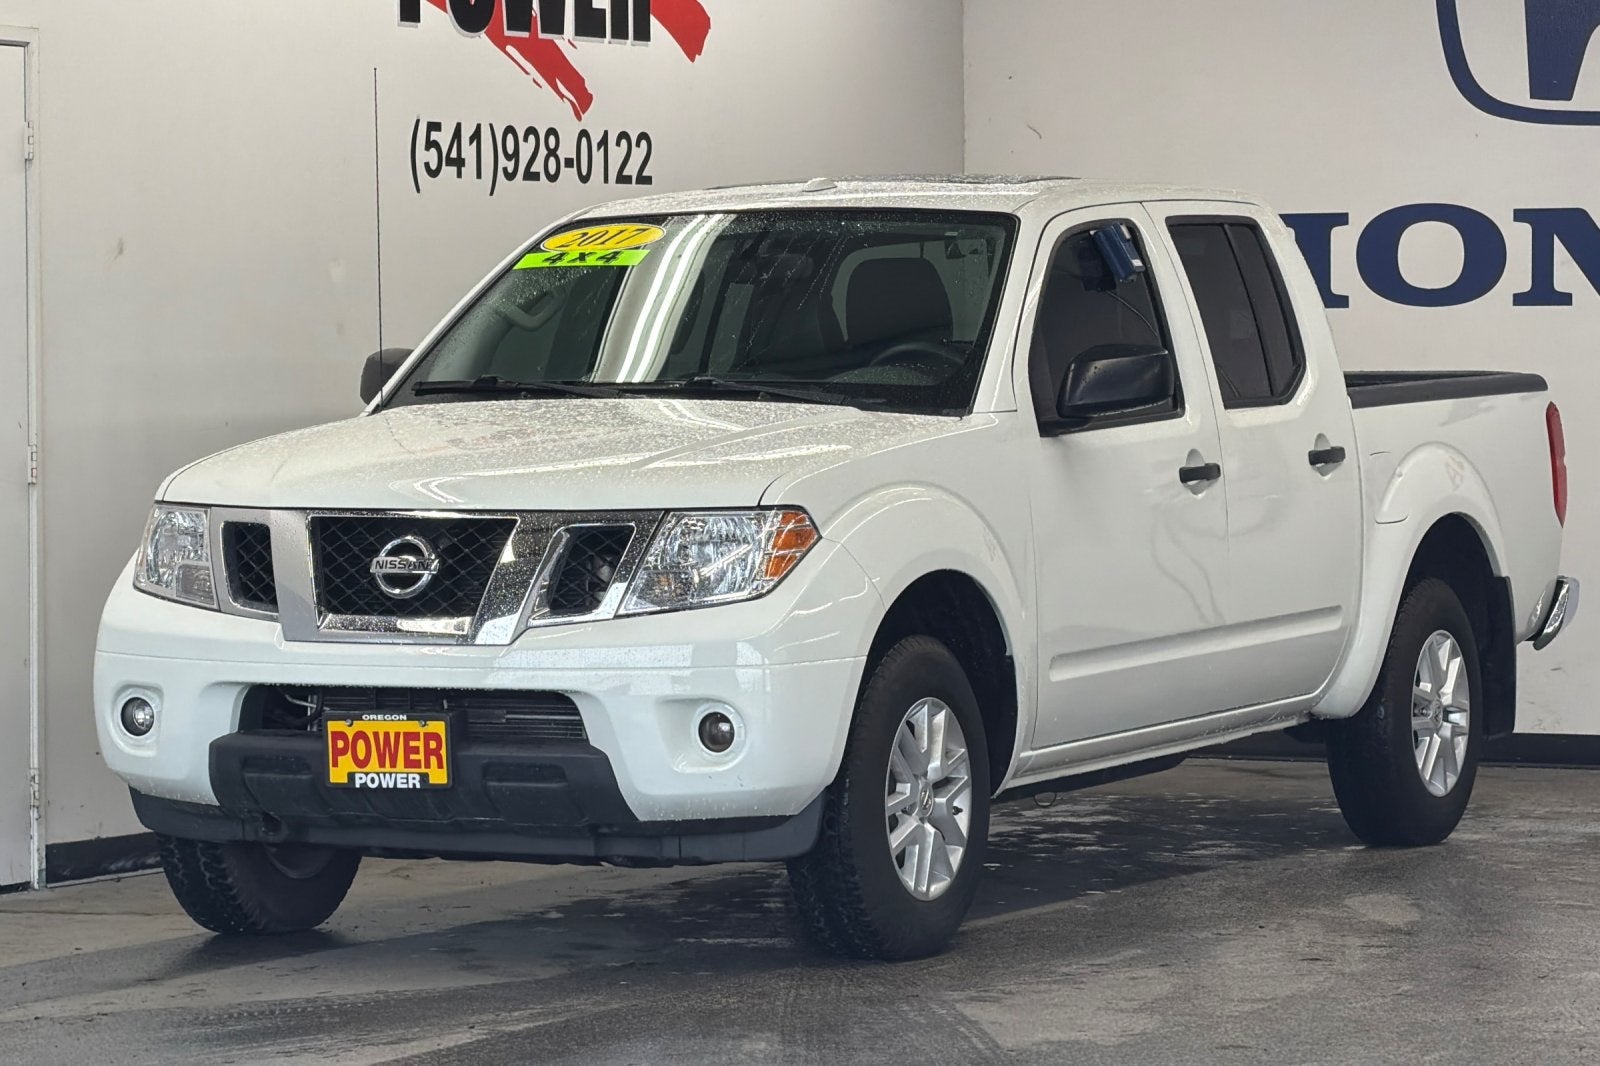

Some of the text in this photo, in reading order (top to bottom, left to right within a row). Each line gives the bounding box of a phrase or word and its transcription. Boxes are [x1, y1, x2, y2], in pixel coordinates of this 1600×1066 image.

[410, 118, 653, 196] (541)928-0122
[556, 228, 650, 249] 2017
[375, 560, 430, 570] NISSAN
[330, 730, 444, 769] POWER
[354, 773, 421, 789] POWER
